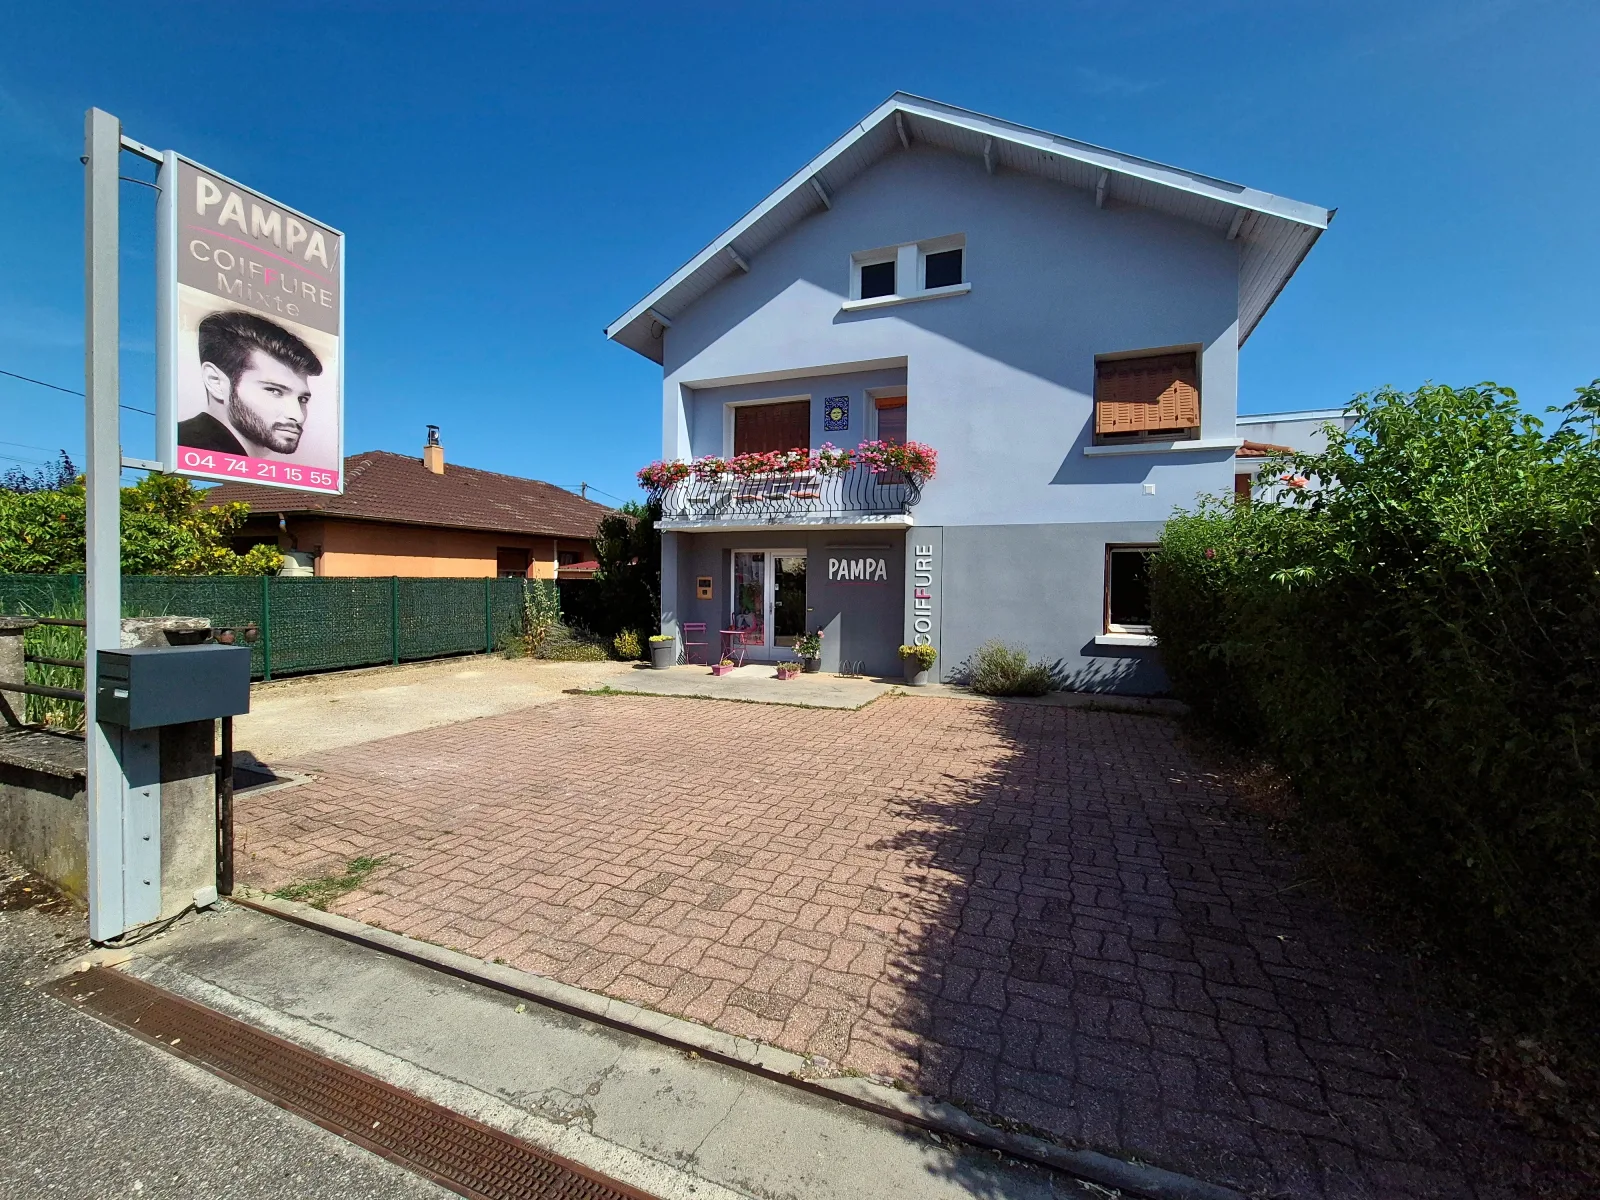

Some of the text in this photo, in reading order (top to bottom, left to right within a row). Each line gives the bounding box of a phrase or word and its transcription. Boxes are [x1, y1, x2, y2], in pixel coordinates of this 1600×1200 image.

[196, 175, 328, 269] PAMPA
[189, 240, 333, 309] COIFFURE
[217, 272, 300, 317] Mixte
[184, 452, 332, 486] 04 74 21 15 55
[828, 558, 887, 581] PAMPA
[914, 544, 933, 646] COIFFURE
